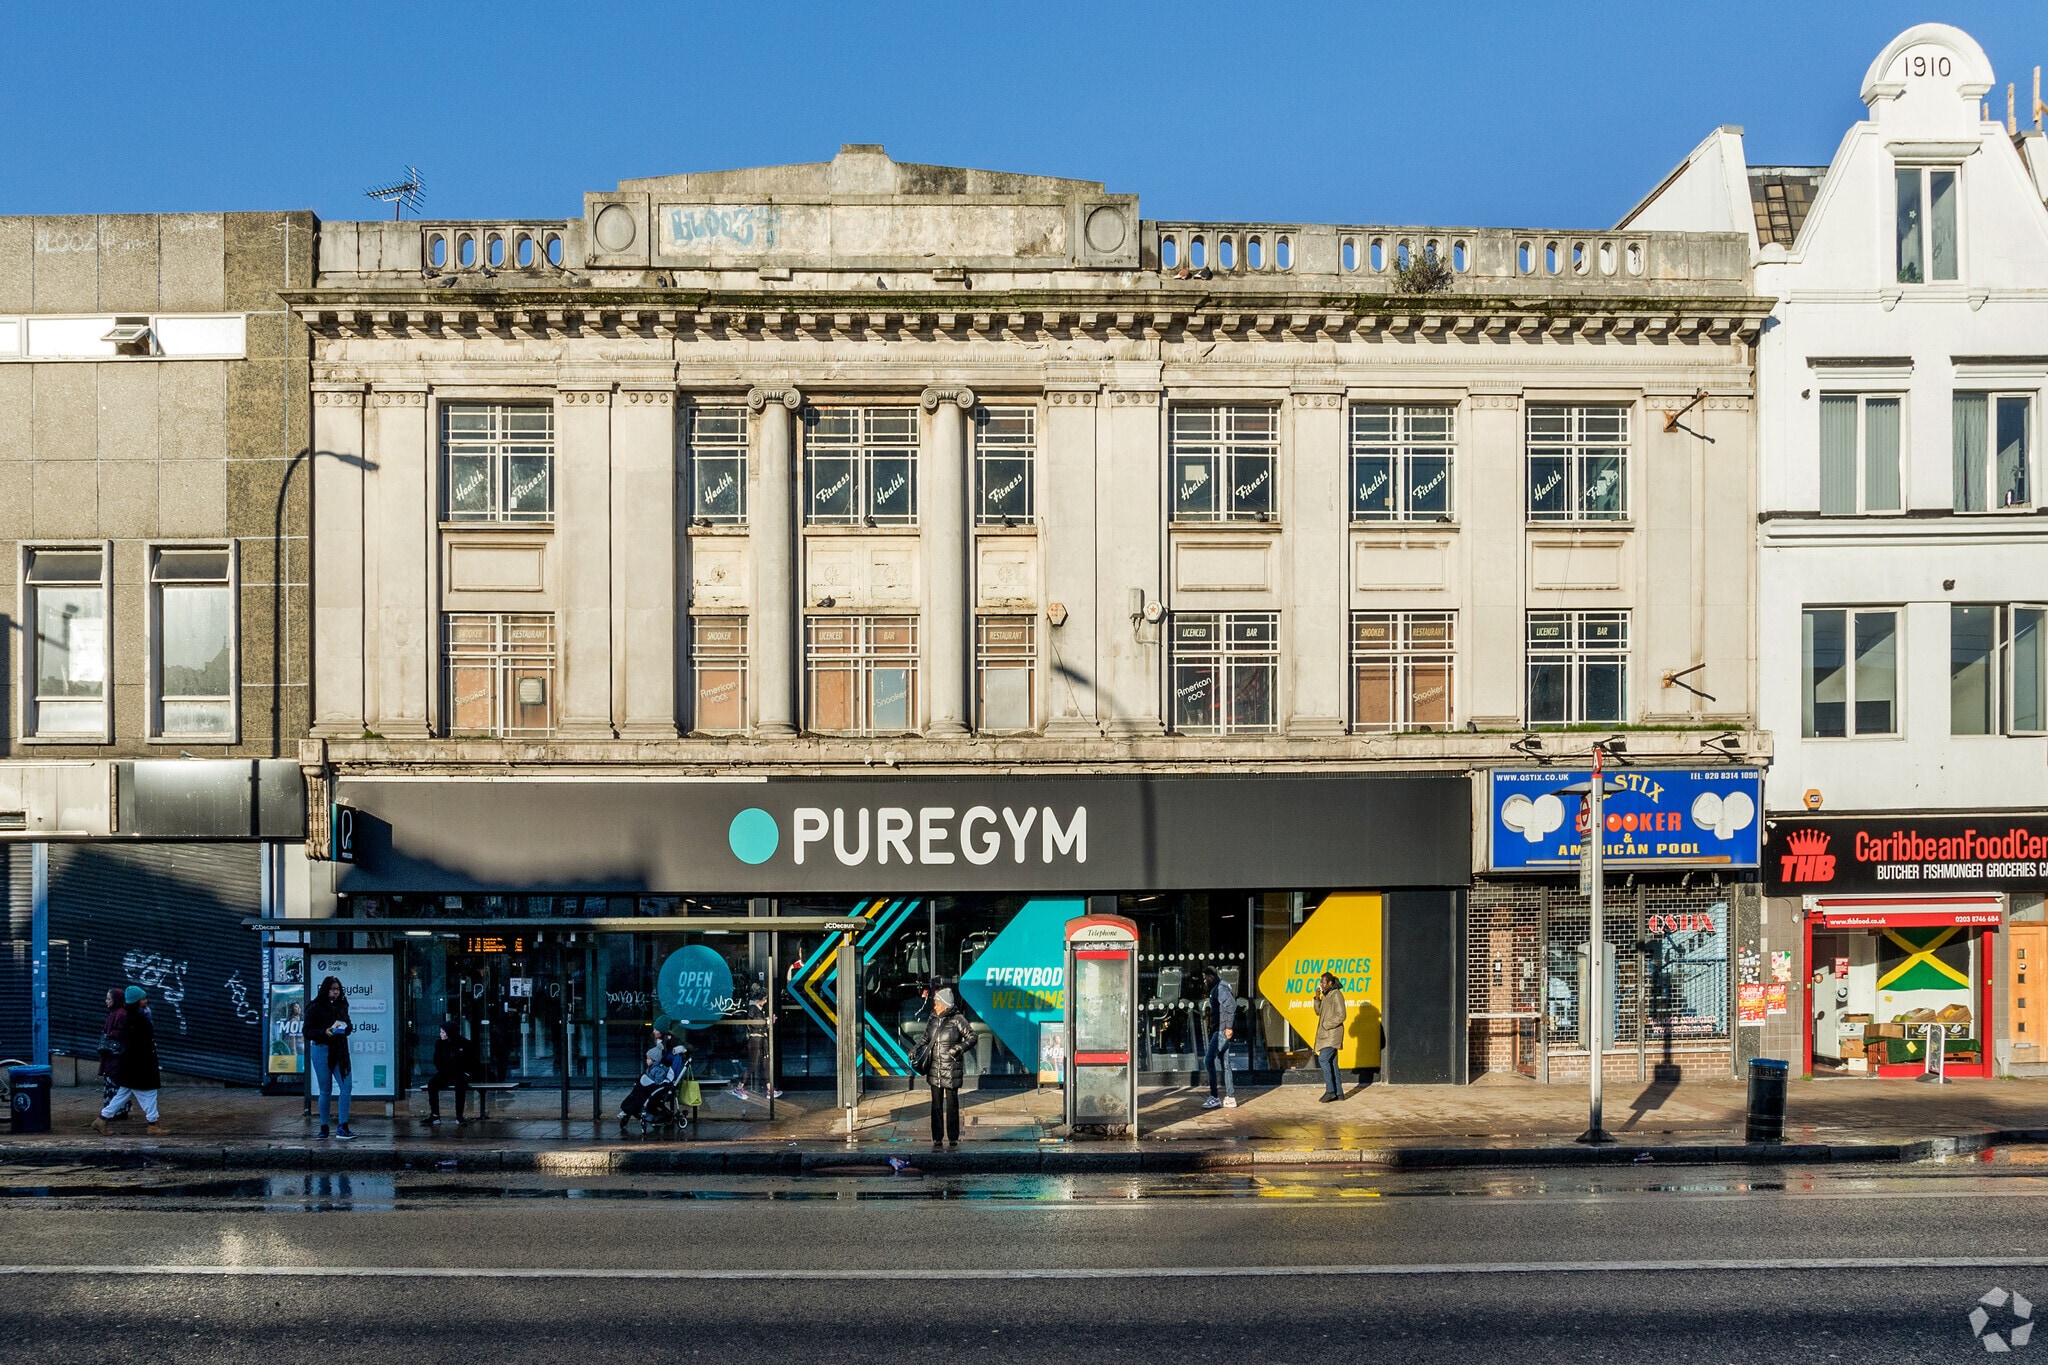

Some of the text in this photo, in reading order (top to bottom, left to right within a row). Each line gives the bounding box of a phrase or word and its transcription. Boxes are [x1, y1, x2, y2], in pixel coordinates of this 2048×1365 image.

[1904, 56, 1951, 77] 1910
[455, 469, 484, 501] Health
[511, 469, 546, 499] Fitness
[704, 472, 734, 505] Health
[815, 472, 850, 503] Fitness
[876, 473, 905, 505] Health
[988, 473, 1024, 503] Fitness
[1235, 469, 1269, 500] Fitness
[1359, 470, 1388, 501] Health
[1412, 470, 1446, 500] Fitness
[1534, 470, 1561, 501] Health
[512, 629, 546, 639] RESTAURANT
[707, 631, 732, 640] SNOOKER
[818, 631, 843, 640] LICENCED
[883, 631, 896, 640] BAR
[989, 631, 1023, 640] RESTAURANT
[1182, 628, 1207, 637] LICENCED
[1246, 628, 1258, 637] BAR
[1360, 628, 1385, 637] SNOOKER
[1412, 627, 1445, 637] RESTAURANT
[1536, 627, 1560, 636] LICENCED
[1596, 627, 1608, 636] BAR
[700, 681, 736, 698] American
[1177, 677, 1212, 698] American
[1412, 685, 1444, 702] Snooker
[711, 693, 728, 704] POOL
[876, 690, 907, 708] Snooker
[1188, 689, 1206, 703] POOL
[1704, 772, 1719, 780] 020
[1721, 771, 1739, 780] 8314
[1603, 774, 1665, 804] STIX
[1575, 812, 1682, 832] OOKER
[793, 805, 1087, 866] PUREGYM
[1623, 832, 1633, 843] &
[1558, 843, 1700, 856] AMICAN POOL
[1780, 854, 1836, 883] THB
[1877, 864, 1920, 880] BUTCHER
[1923, 862, 1984, 879] FISHMONGER
[1986, 861, 2037, 878] GROCERIES
[1829, 914, 1999, 926] www.thbfood.co.uk 0203 8746 684
[1087, 929, 1118, 938] Telephone
[1294, 958, 1371, 974] LOW PRICES
[678, 971, 714, 987] OPEN
[1286, 978, 1303, 994] NO
[1289, 999, 1302, 1010] join
[359, 1021, 380, 1033] day.
